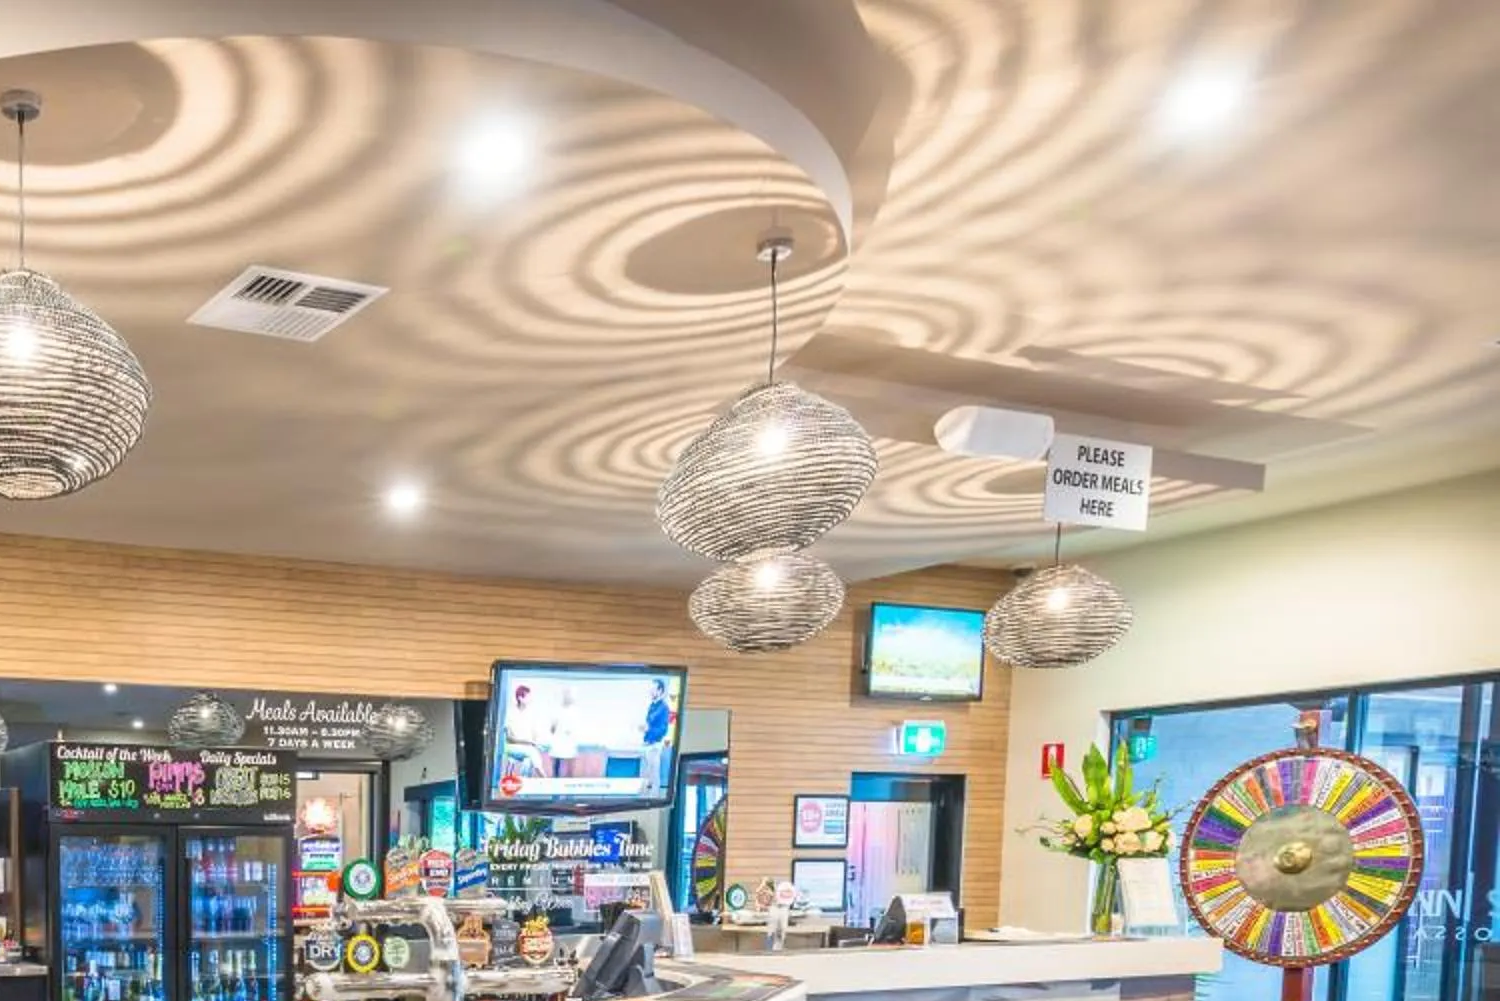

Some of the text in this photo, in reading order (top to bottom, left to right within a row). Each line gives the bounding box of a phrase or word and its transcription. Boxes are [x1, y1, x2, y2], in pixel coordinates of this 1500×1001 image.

[1077, 445, 1125, 467] PLEASE
[1053, 468, 1145, 495] ORDER MEALS
[1080, 498, 1114, 518] HERE
[246, 697, 379, 725] Meals Available
[267, 737, 356, 749] 7 DAYS A WEEK
[57, 745, 105, 760] Cocktail
[106, 747, 119, 763] of
[120, 748, 137, 761] the
[200, 750, 277, 767] Daily Specials
[108, 779, 135, 799] $10
[480, 832, 654, 862] Friday Bubbles Time
